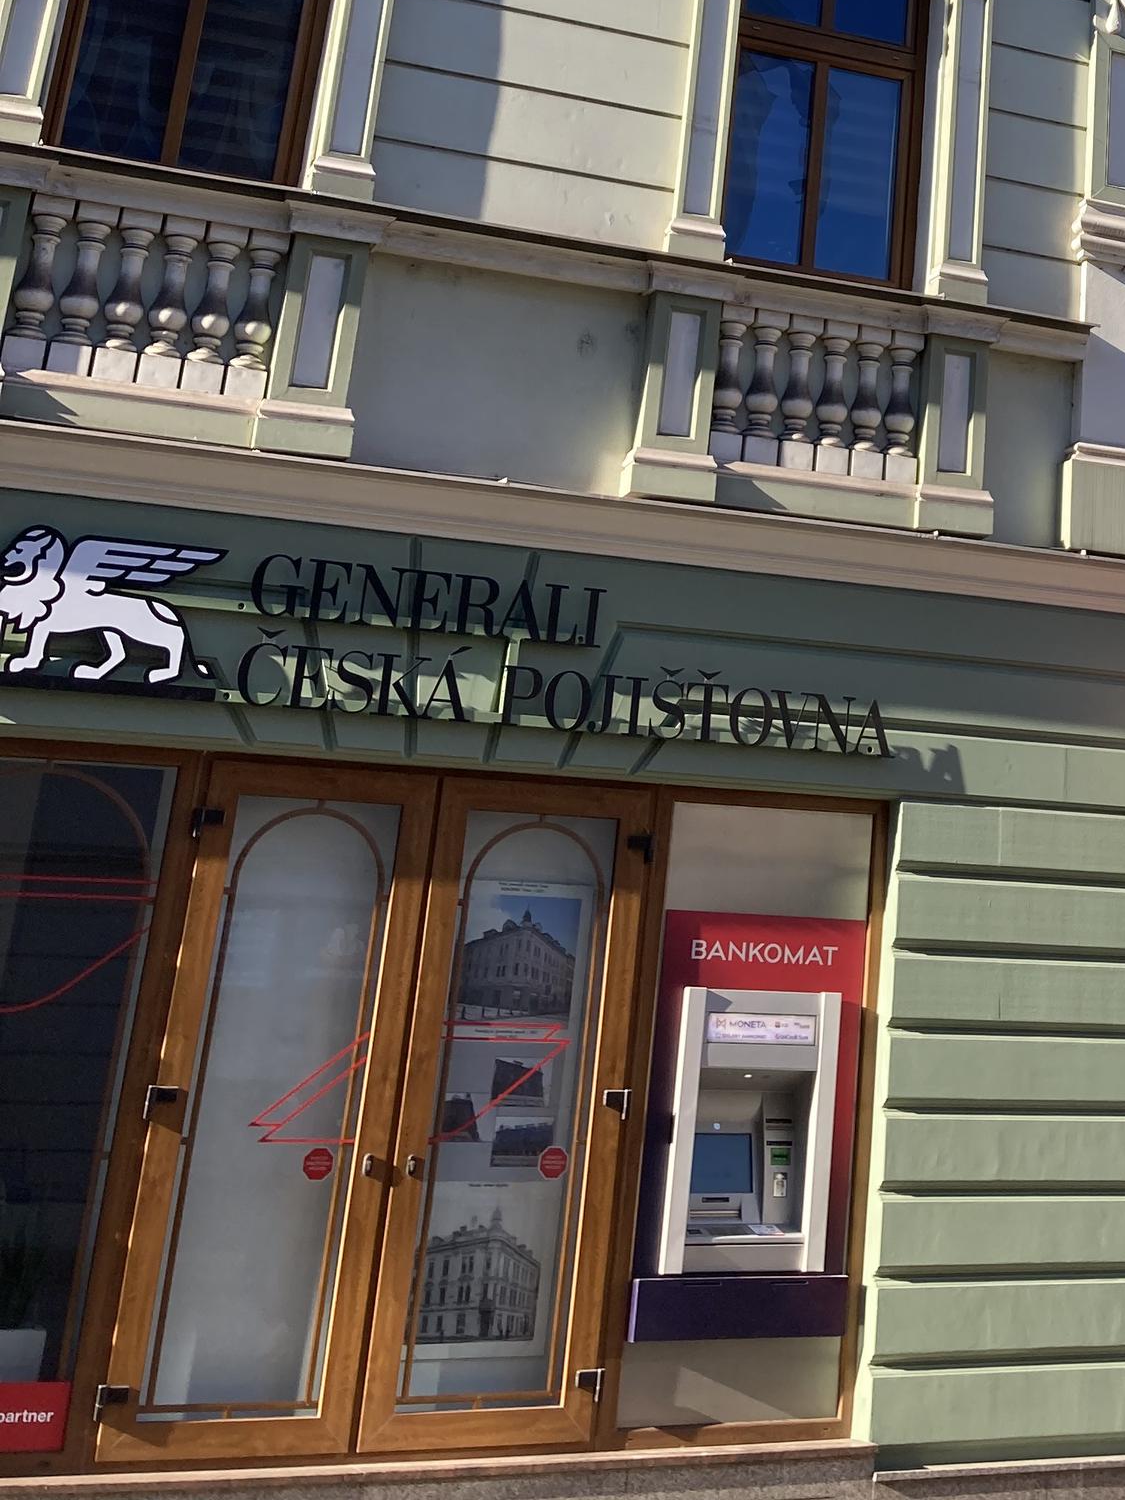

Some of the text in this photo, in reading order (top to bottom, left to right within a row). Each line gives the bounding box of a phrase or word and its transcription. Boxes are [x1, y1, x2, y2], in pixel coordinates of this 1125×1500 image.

[250, 553, 608, 648] GENERALI
[237, 626, 896, 759] ČESKÁ POJIŠŤOVNA
[690, 939, 838, 966] BANKOMAT
[729, 1020, 767, 1029] MONETA
